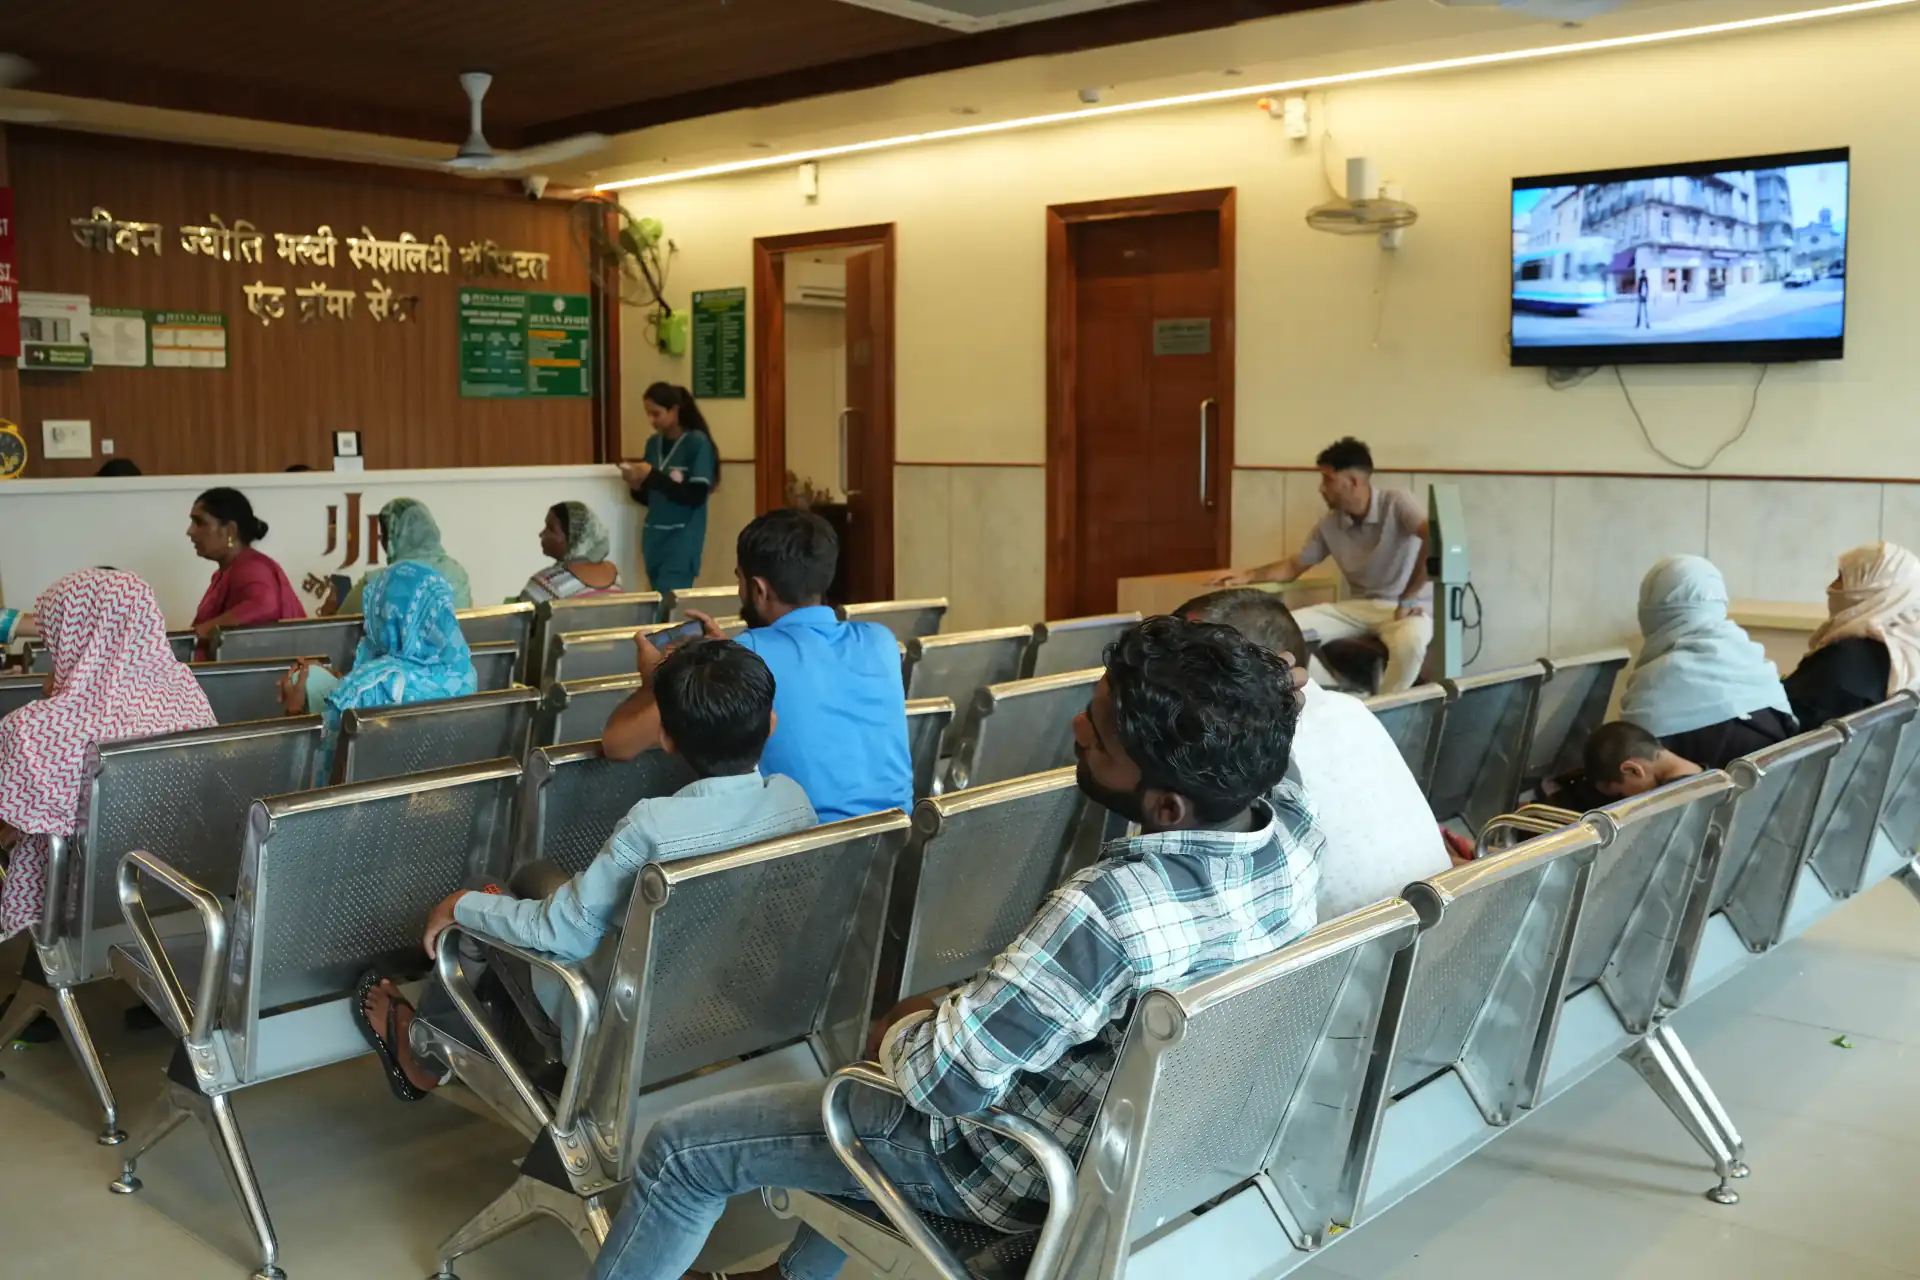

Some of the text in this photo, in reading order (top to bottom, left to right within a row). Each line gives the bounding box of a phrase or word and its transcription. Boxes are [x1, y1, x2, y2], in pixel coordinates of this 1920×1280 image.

[69, 206, 163, 256] जीवन
[180, 212, 265, 264] ज्योति
[274, 225, 338, 268] मल्टी
